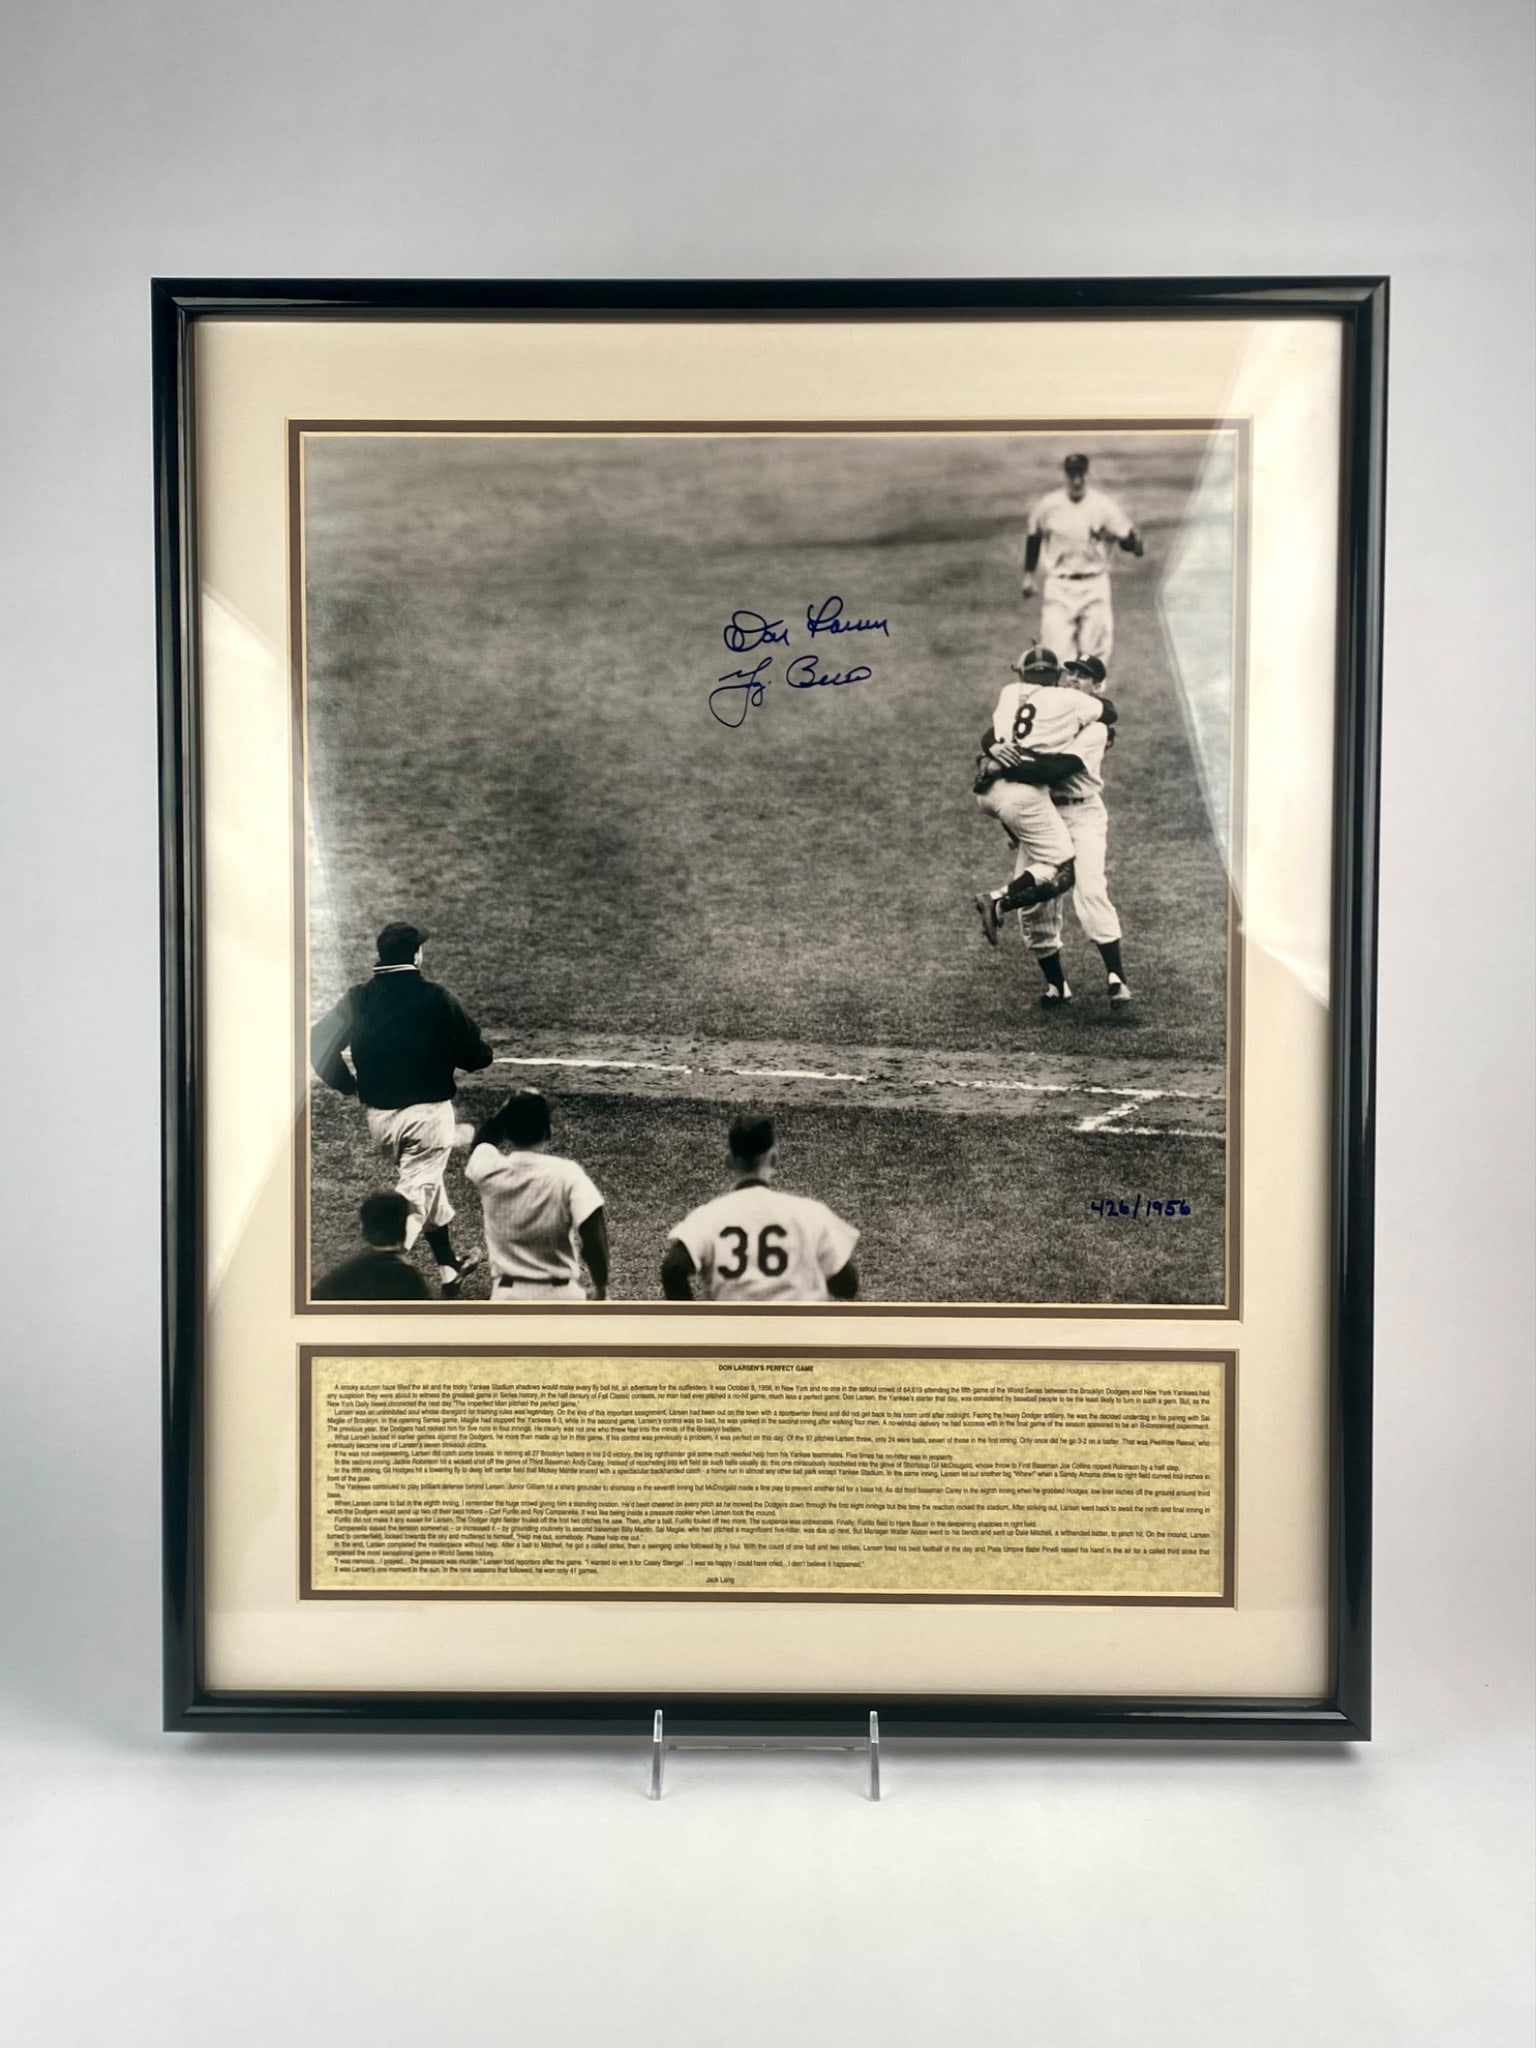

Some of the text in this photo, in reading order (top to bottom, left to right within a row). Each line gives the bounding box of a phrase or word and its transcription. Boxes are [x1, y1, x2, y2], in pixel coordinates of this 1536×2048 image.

[724, 610, 790, 652] Don
[1013, 703, 1036, 740] 8
[1090, 1194, 1191, 1220] 426/1956
[717, 1225, 789, 1278] 36
